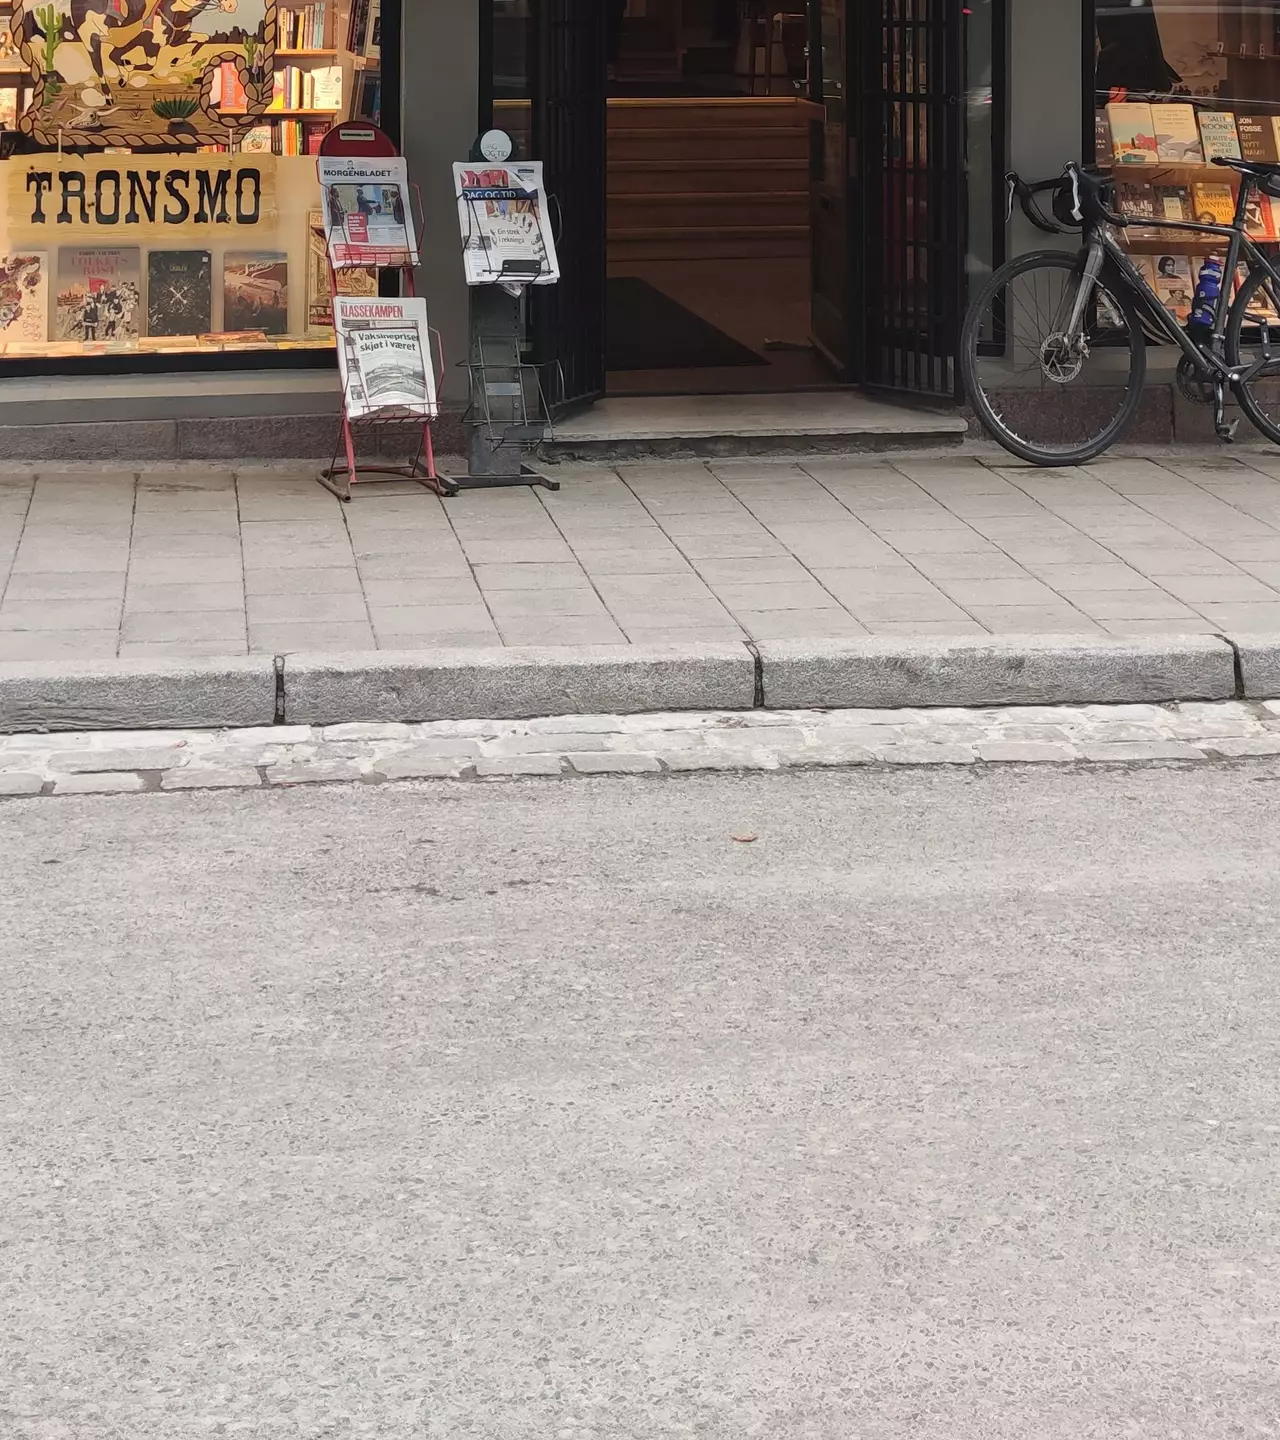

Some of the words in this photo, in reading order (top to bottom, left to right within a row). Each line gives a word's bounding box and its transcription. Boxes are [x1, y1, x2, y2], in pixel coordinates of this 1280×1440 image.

[1202, 123, 1234, 131] ROONEY
[1240, 125, 1263, 133] FOSSE
[323, 169, 392, 177] MORGENBLADET
[26, 170, 262, 225] TRONSMO
[340, 303, 404, 319] KLASSEKAMPEN
[360, 342, 384, 352] skjøt
[390, 341, 416, 351] været
